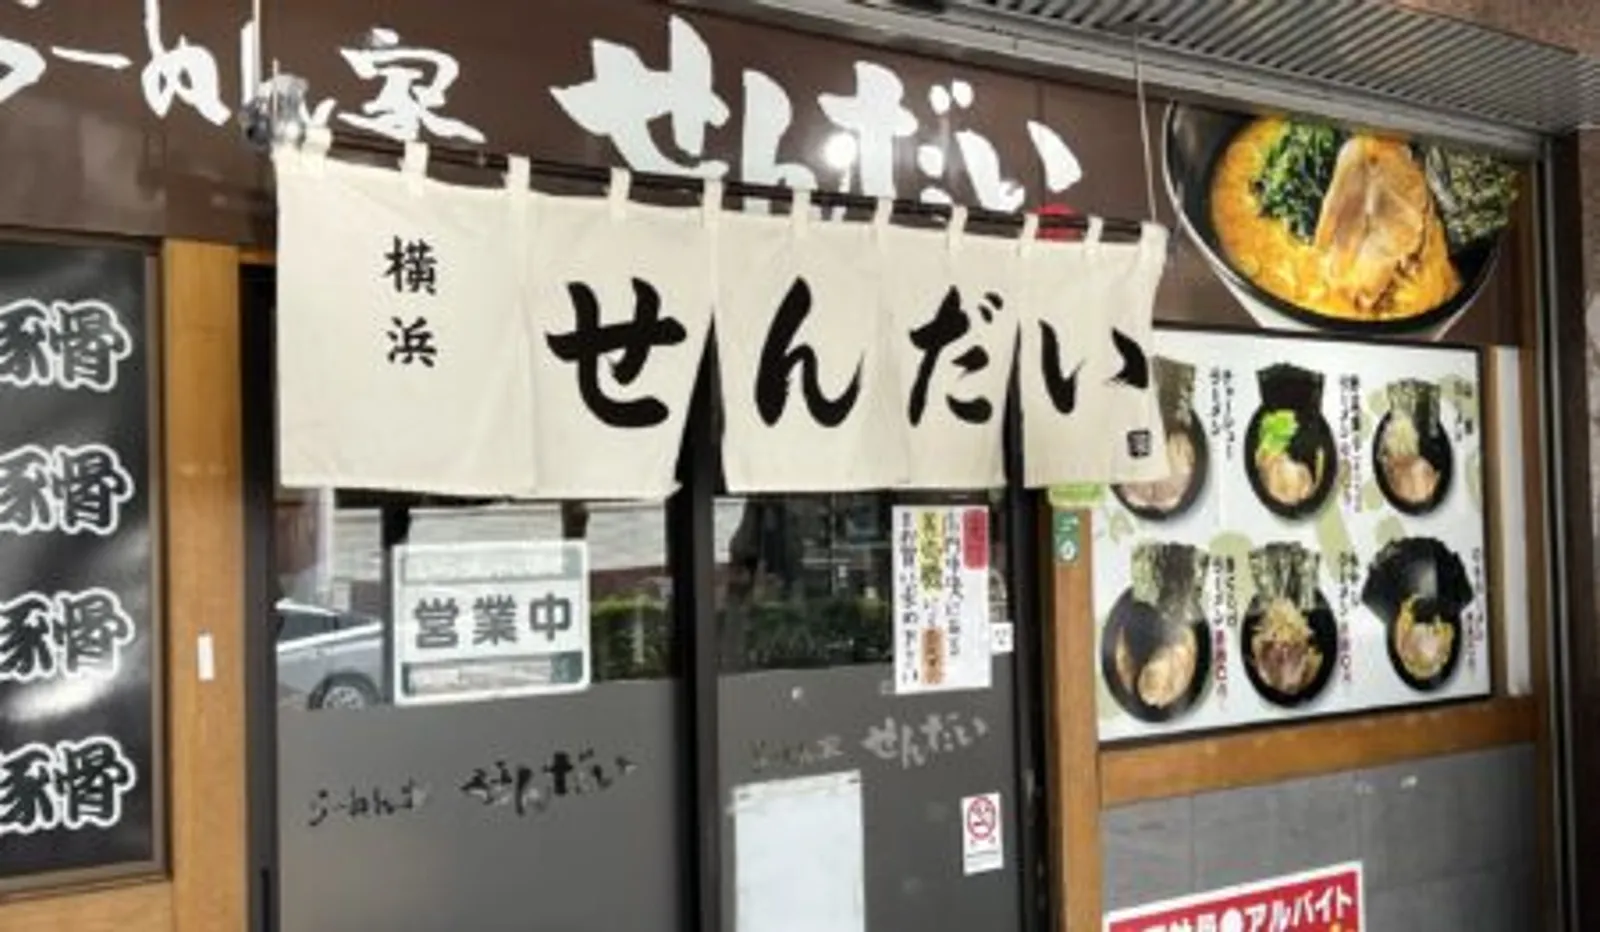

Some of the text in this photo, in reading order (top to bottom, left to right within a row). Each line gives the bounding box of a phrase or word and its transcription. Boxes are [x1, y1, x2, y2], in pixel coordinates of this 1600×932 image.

[550, 14, 1082, 221] せんだい
[384, 235, 438, 367] 横浜
[545, 277, 1149, 427] せんだい
[414, 591, 572, 649] 営業中
[861, 714, 989, 769] せんだい
